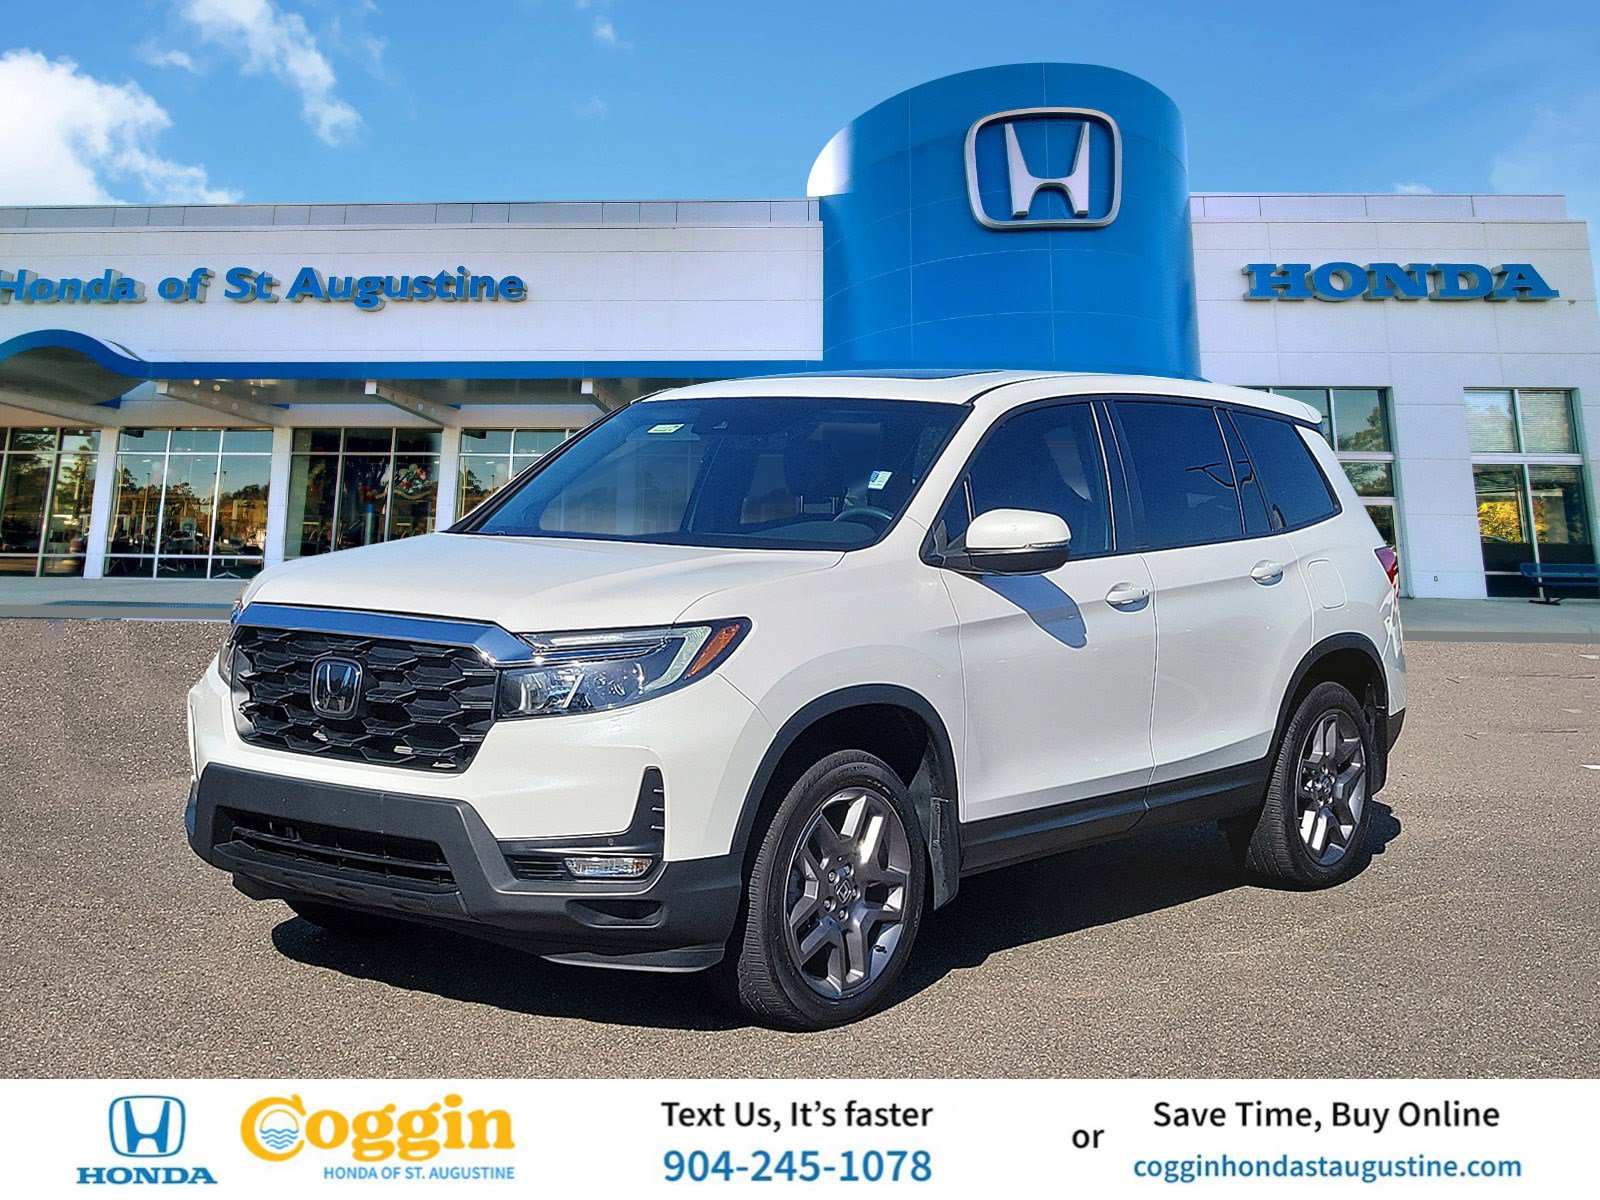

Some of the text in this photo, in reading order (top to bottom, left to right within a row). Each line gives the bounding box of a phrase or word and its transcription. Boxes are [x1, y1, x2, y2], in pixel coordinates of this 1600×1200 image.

[0, 265, 527, 311] Honda of St Augustine
[1243, 261, 1560, 302] HONDA
